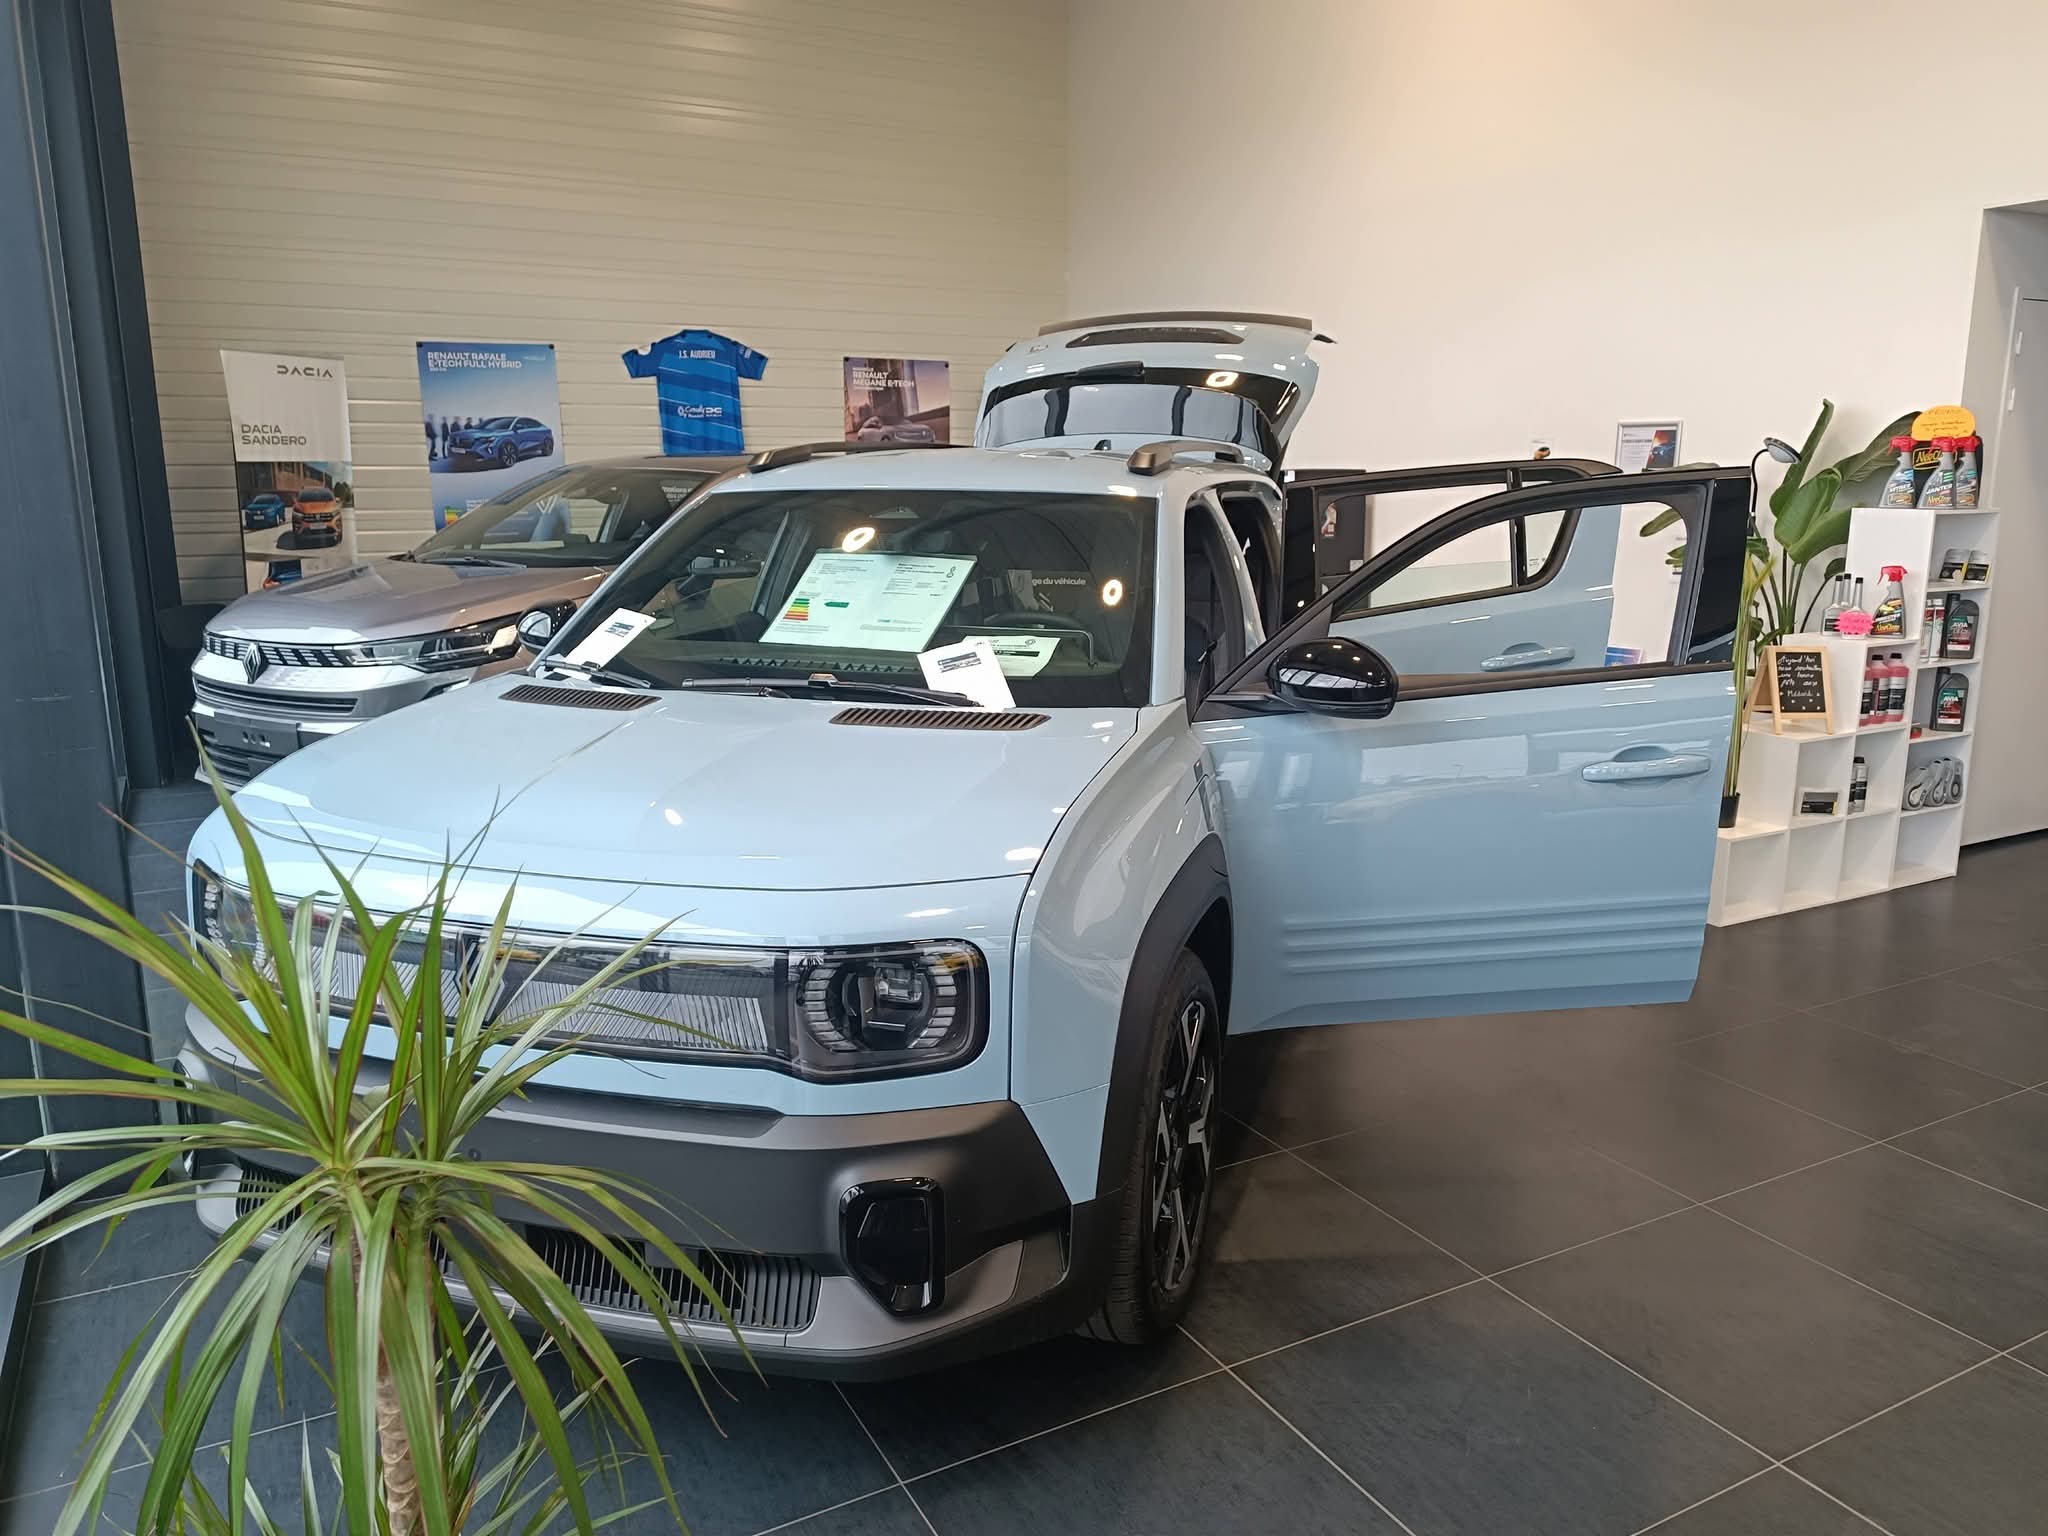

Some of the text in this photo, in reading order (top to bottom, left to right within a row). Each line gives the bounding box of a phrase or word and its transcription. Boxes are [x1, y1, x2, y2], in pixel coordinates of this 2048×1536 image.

[428, 351, 507, 361] RENAULT RAFALE
[679, 349, 690, 359] J.S.
[429, 359, 522, 369] E-TECH FULL HYBRID
[276, 364, 334, 378] DACIA
[853, 371, 889, 379] RENAULT
[887, 379, 915, 388] E-TECH
[241, 423, 282, 434] DACIA
[241, 435, 307, 446] SANDERO
[1043, 577, 1053, 585] du
[1054, 577, 1087, 585] véhicule
